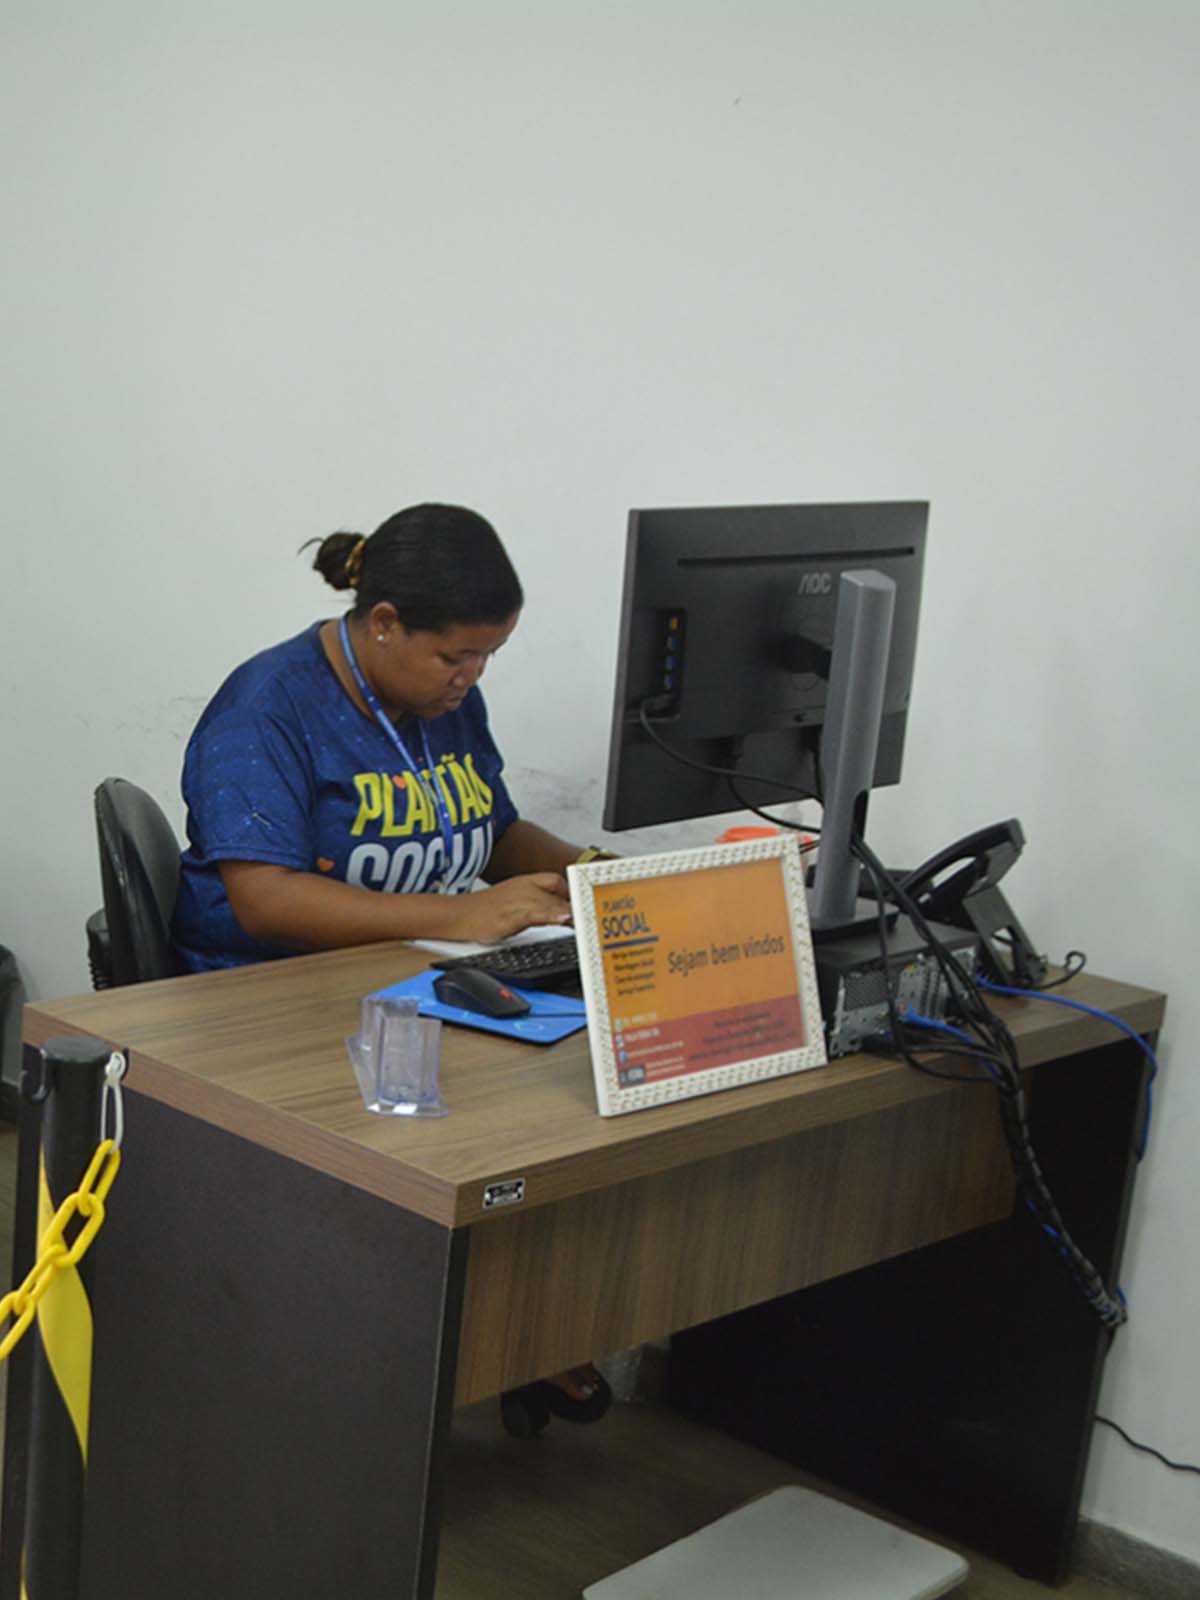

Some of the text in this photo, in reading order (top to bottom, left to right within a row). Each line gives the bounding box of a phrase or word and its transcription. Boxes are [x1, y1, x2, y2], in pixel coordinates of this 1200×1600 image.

[798, 572, 831, 595] AOC
[602, 911, 650, 939] SOCIAL
[667, 949, 708, 977] Sejam
[711, 942, 740, 966] bem
[742, 933, 785, 959] vindos
